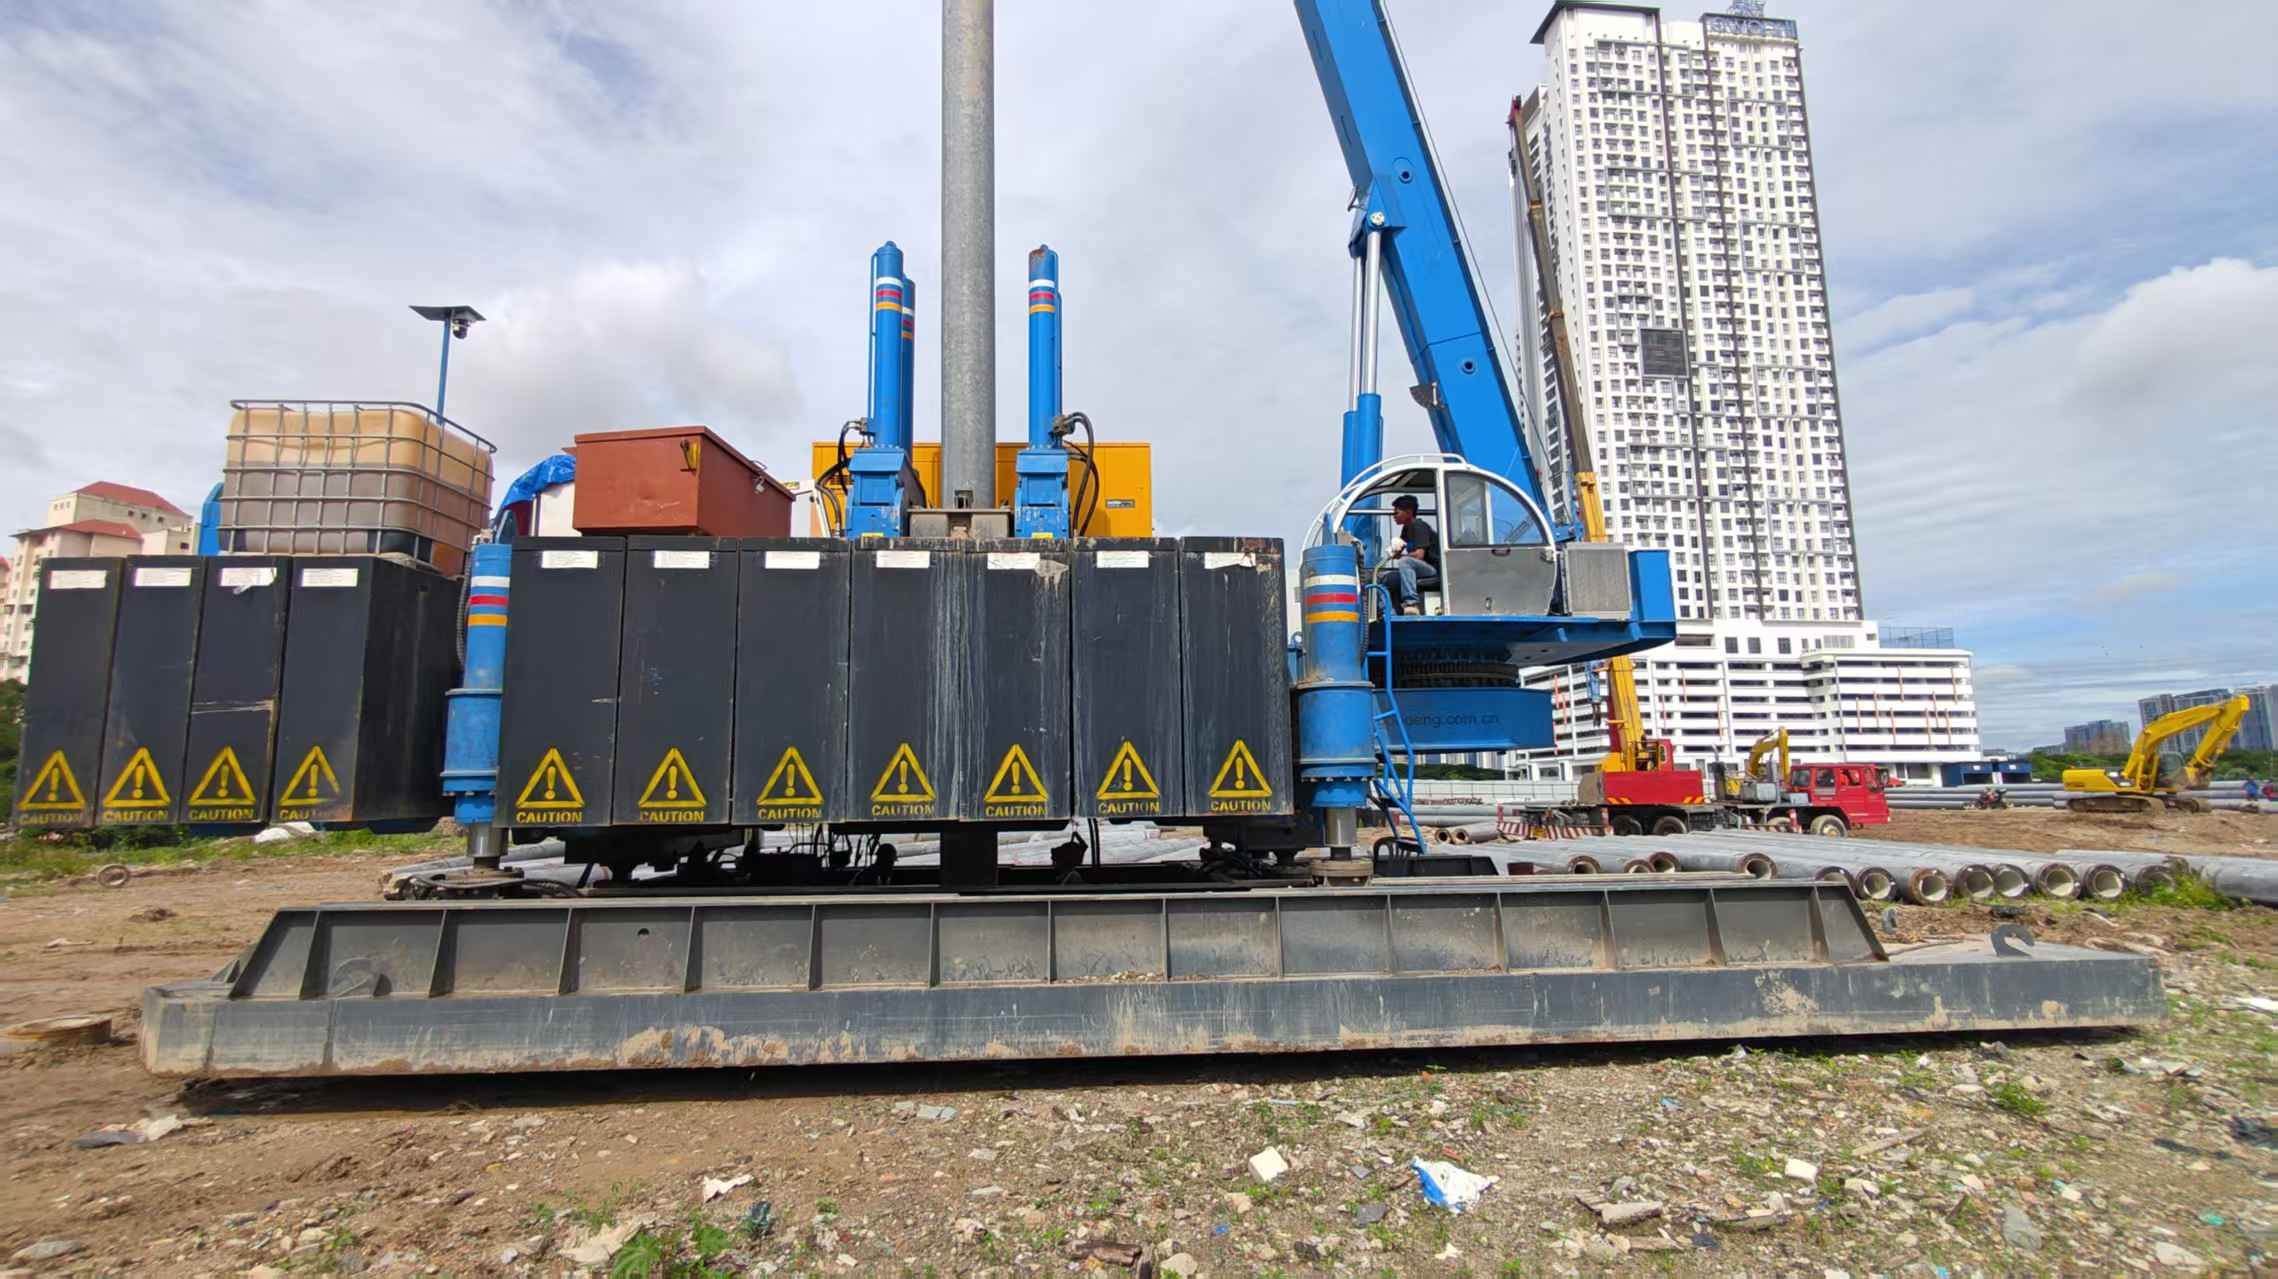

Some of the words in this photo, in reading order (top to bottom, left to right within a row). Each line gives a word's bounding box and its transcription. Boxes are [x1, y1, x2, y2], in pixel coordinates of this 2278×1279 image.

[871, 803, 935, 817] CAUTION
[985, 804, 1048, 818] CAUTION
[1097, 800, 1161, 815] CAUTION
[1210, 798, 1272, 812] CAUTION
[103, 809, 168, 823] CAUTION
[189, 807, 255, 822] CAUTION
[516, 810, 582, 824] CAUTION
[639, 809, 705, 823] CAUTION
[758, 807, 823, 821] CAUTION
